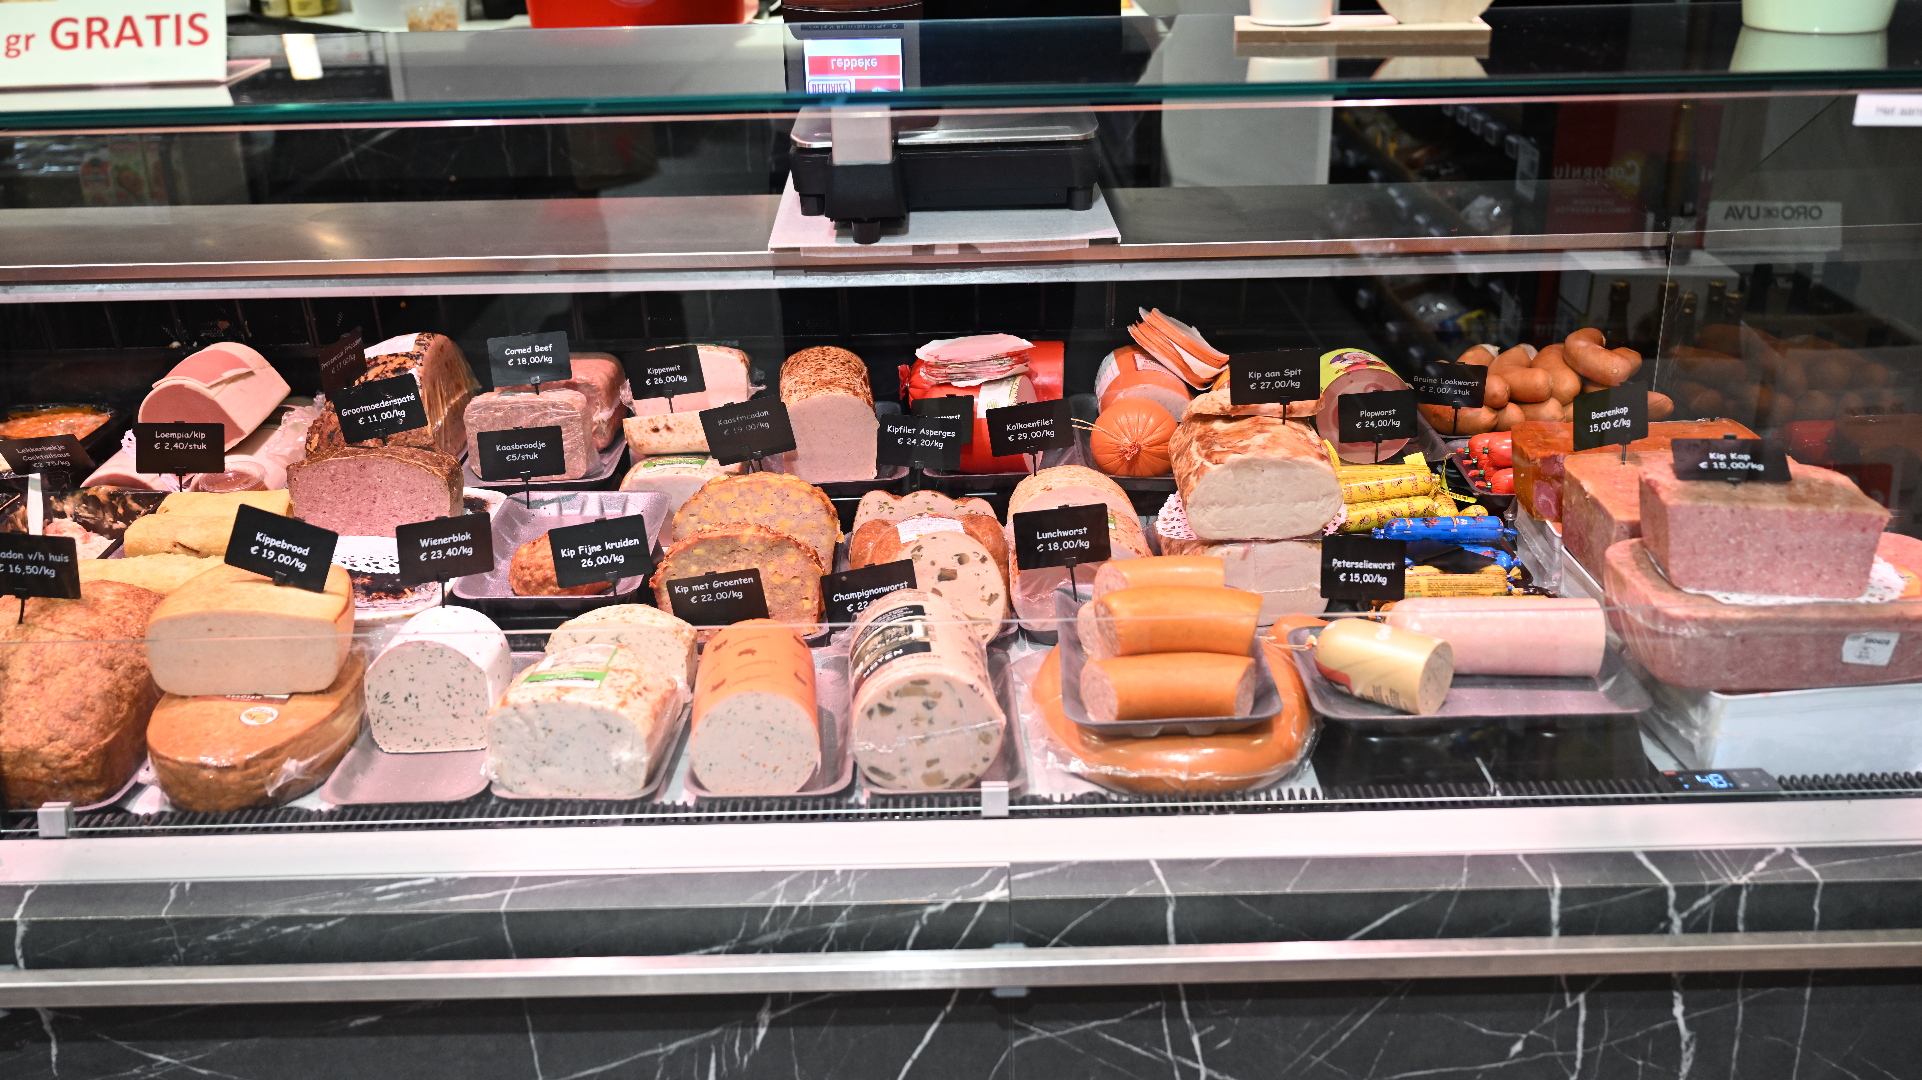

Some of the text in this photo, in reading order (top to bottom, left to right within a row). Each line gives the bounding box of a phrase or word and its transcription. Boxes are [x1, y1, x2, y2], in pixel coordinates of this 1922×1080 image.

[4, 12, 210, 58] gr GRATIS
[504, 343, 553, 357] Corned Beef
[508, 355, 553, 367] € 18,00/kg
[654, 375, 688, 386] 26,00/kg
[1248, 368, 1302, 381] Kip aan Spit
[1413, 375, 1480, 388] Bruine Lookworst
[1250, 380, 1301, 391] € 27,00/kg
[1453, 388, 1471, 396] stuk
[341, 394, 416, 416] Grootmoederspaté
[358, 409, 406, 425] € 11,00/kg
[1360, 408, 1397, 419] Plopworst
[1591, 405, 1629, 420] Boerenkop
[1355, 419, 1401, 430] € 24,00/kg
[1589, 418, 1632, 434] 15,00 €/kg
[155, 430, 206, 442] Loempia/kip
[886, 425, 956, 440] Kipfilet Asperges
[1007, 434, 1015, 443] €
[154, 442, 207, 451] € 2,40/stuk
[496, 440, 546, 452] Kaasbroodje
[897, 437, 944, 450] € 24,20/kg
[505, 452, 539, 463] €5/stuk
[1708, 452, 1727, 462] Kip
[1698, 461, 1765, 471] € 15,00/kg
[419, 531, 472, 548] Wienerblok
[1036, 526, 1088, 541] Lunchworst
[255, 531, 310, 556] Kippebrood
[560, 538, 640, 560] Kip Fijne kruiden
[1036, 539, 1090, 553] € 18,00/kg
[27, 551, 45, 562] v/h
[48, 552, 70, 563] huis
[250, 545, 308, 572] € 19,00/kg
[419, 546, 473, 561] € 23,40/kg
[580, 553, 625, 569] 26,00/kg
[1331, 557, 1396, 571] Peterselieworst
[8, 563, 57, 579] 16,50/kg
[1339, 572, 1388, 587] € 15,00/kg
[674, 576, 755, 599] Kip met Groenten
[832, 580, 910, 603] Champignonworst
[690, 590, 744, 605] € 22,00/kg
[846, 603, 854, 612] €
